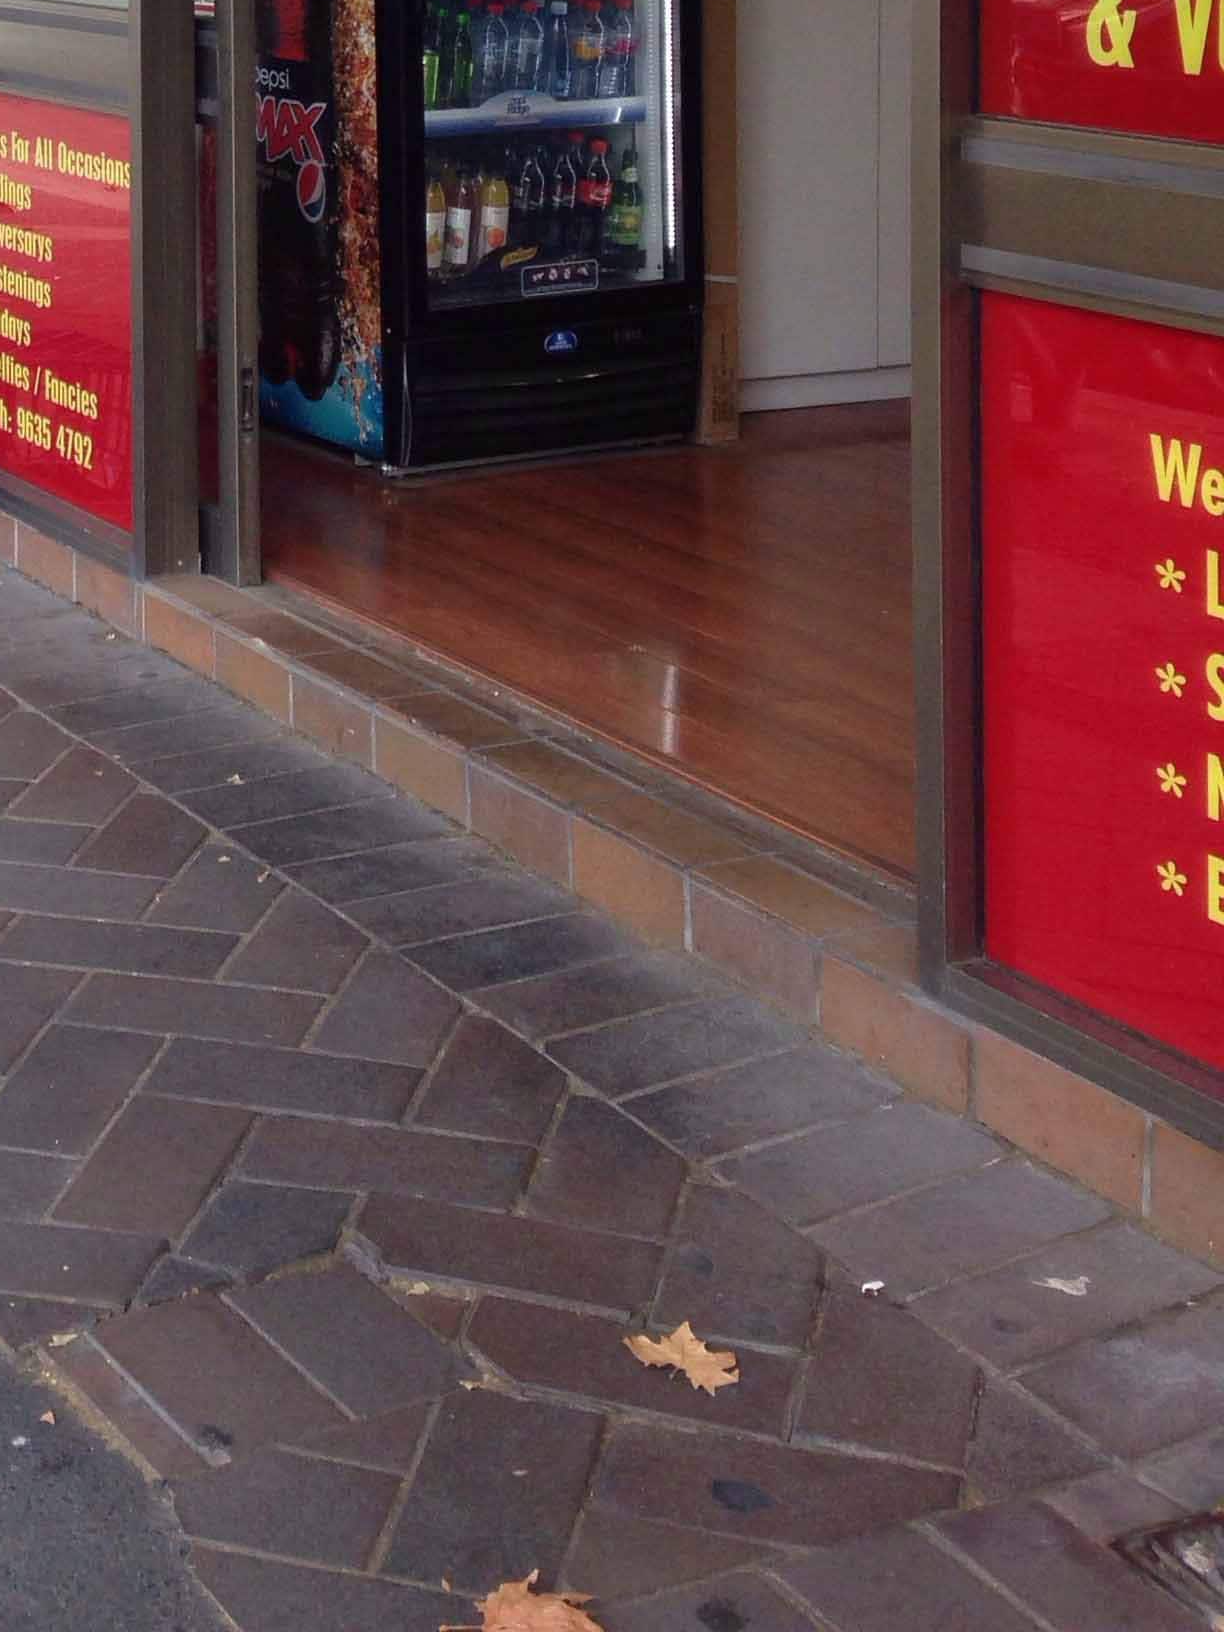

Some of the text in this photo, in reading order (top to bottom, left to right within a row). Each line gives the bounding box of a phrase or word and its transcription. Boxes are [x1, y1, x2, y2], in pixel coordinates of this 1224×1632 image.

[11, 129, 29, 165] For
[34, 135, 53, 172] All
[57, 141, 131, 190] Occasions
[44, 369, 99, 421] Fancies
[16, 406, 52, 452] 9635
[55, 424, 94, 471] 4792
[1150, 432, 1224, 517] We
